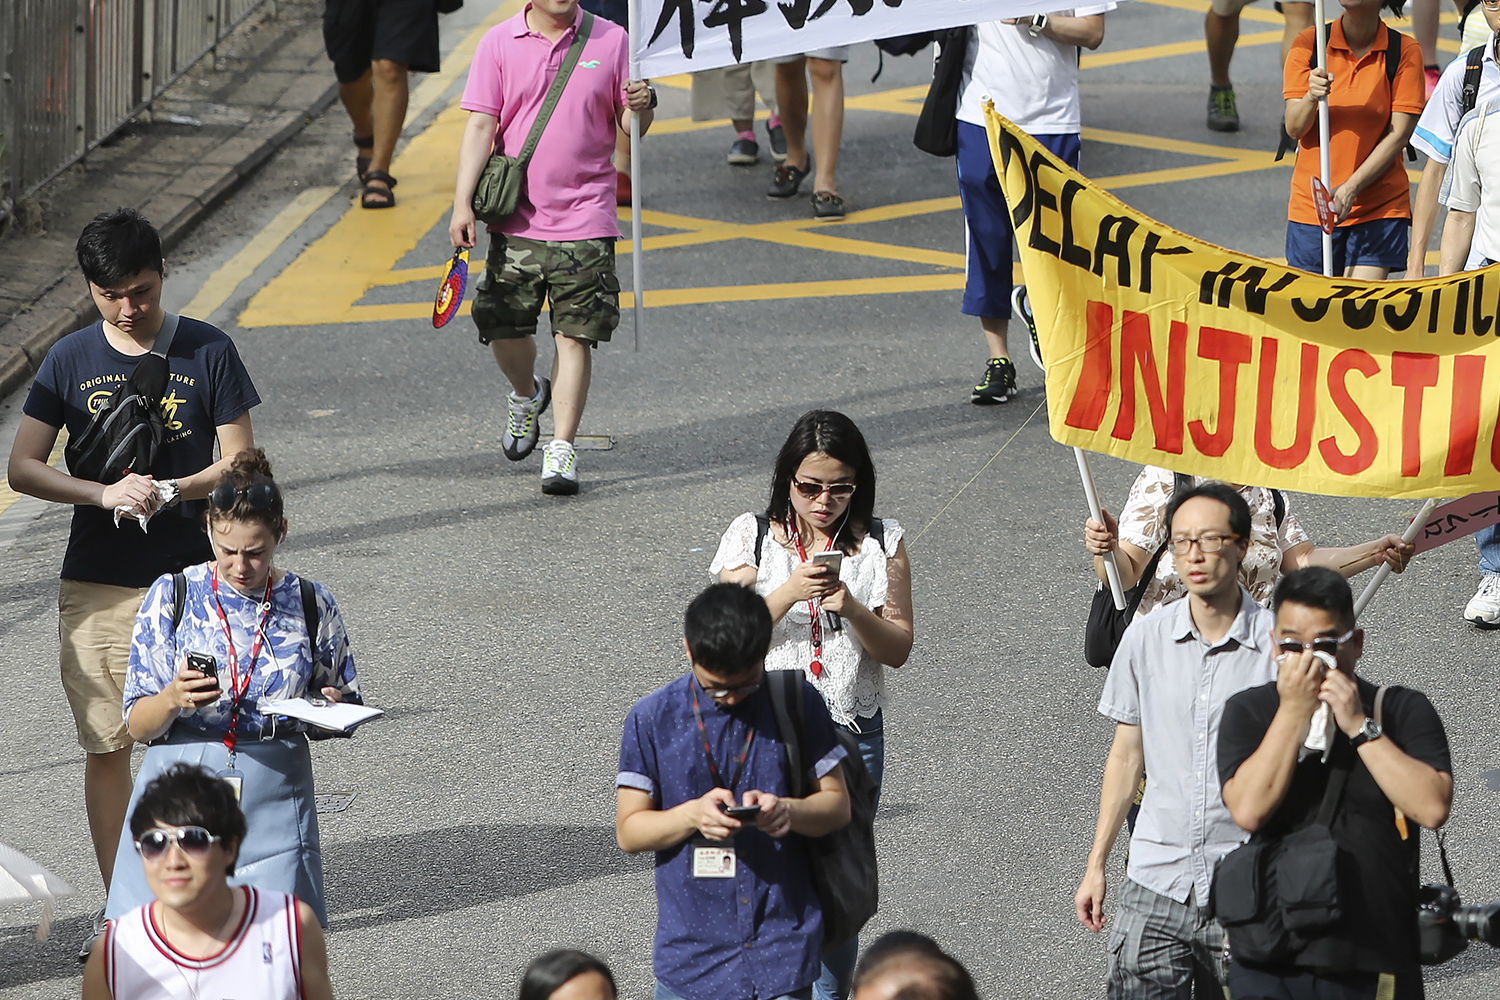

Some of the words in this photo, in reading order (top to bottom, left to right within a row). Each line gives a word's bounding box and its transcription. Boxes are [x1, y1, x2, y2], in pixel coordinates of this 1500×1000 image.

[1000, 126, 1193, 293] DELAY
[80, 373, 128, 391] ORIGINAL
[165, 429, 193, 444] LAZING
